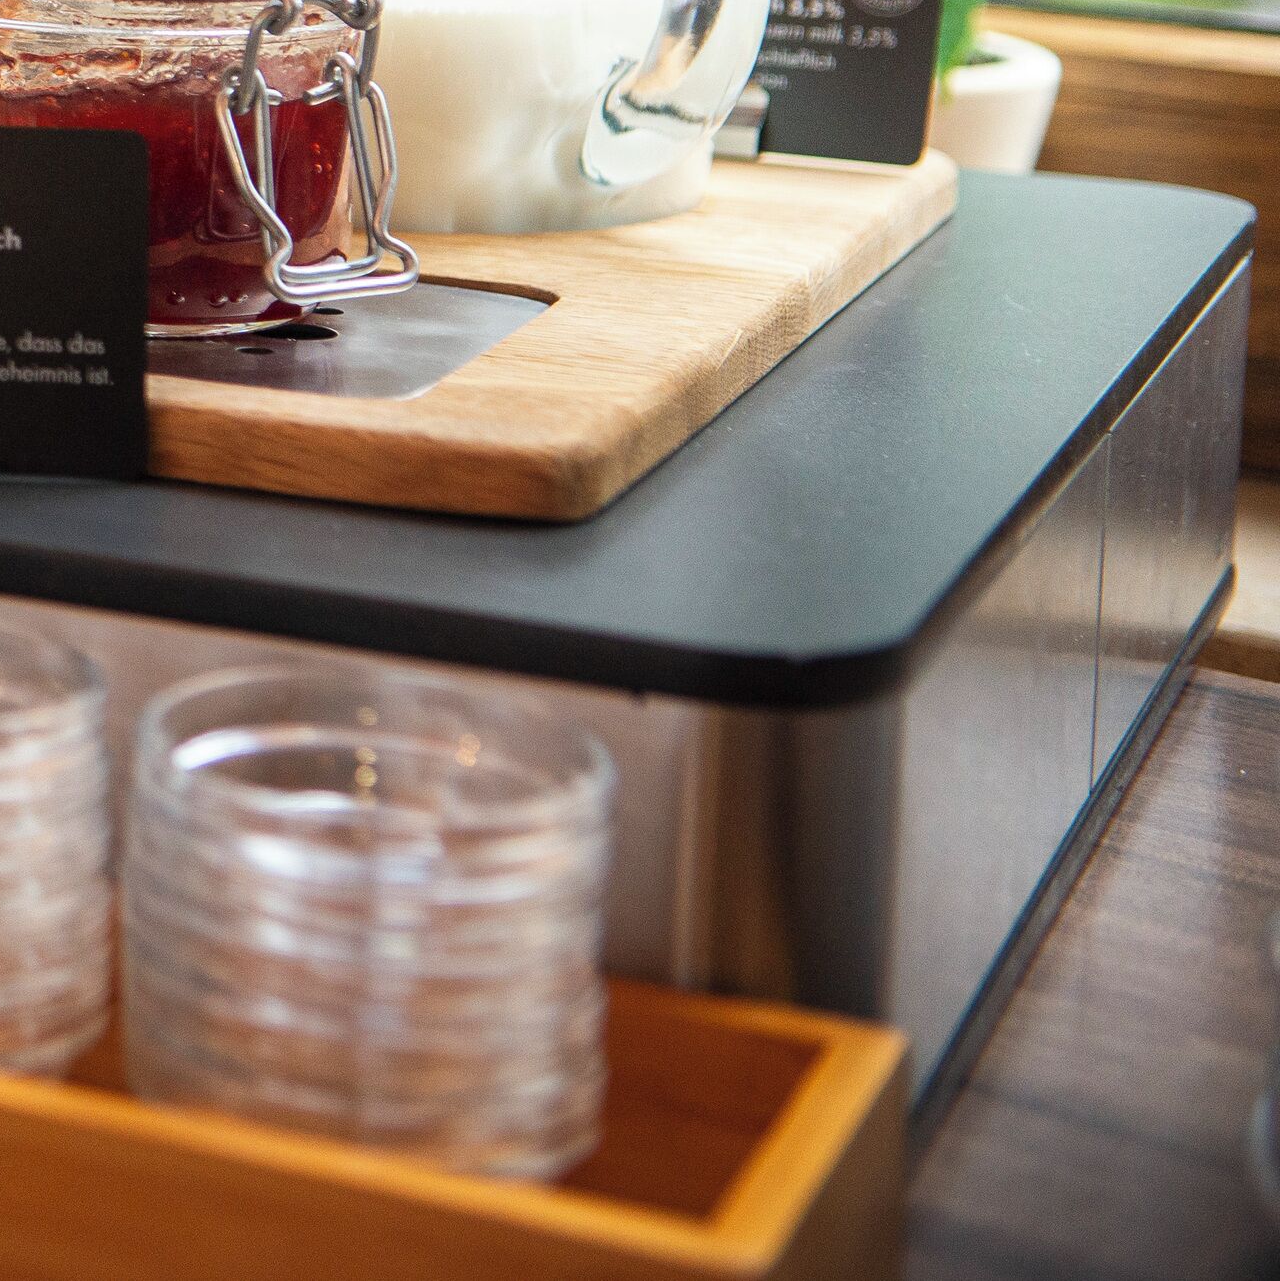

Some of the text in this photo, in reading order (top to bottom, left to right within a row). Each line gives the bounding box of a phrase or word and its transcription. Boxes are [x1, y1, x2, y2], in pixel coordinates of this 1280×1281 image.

[16, 329, 63, 354] dass
[66, 330, 106, 356] das
[86, 368, 115, 386] ist.
